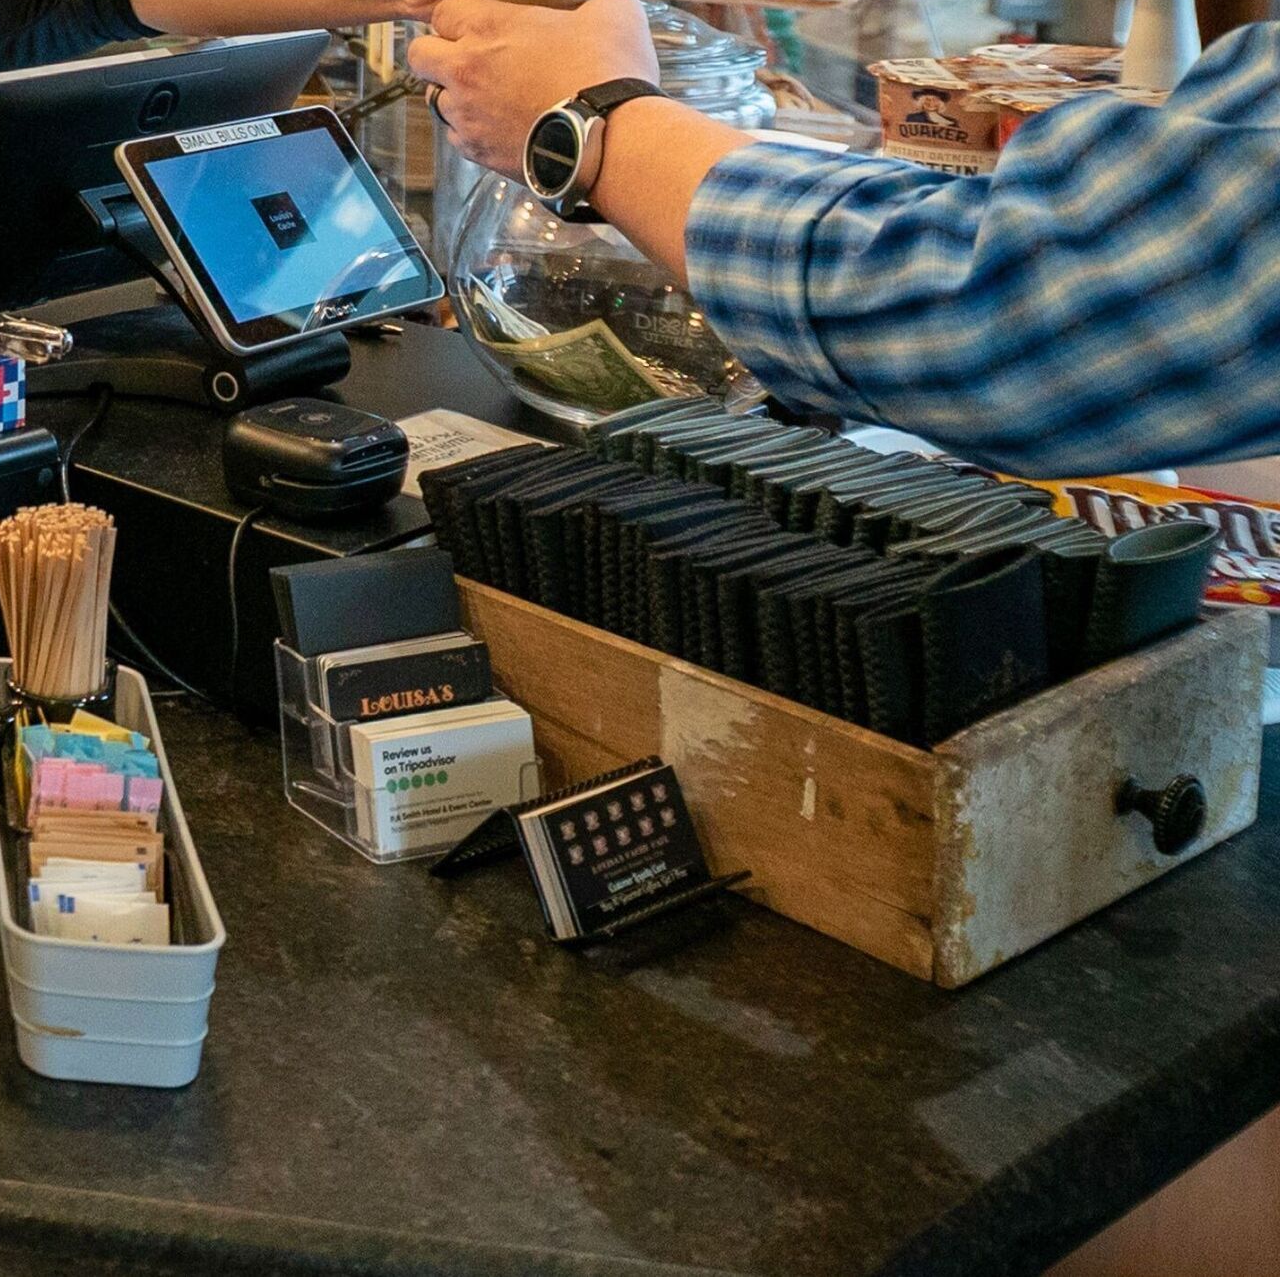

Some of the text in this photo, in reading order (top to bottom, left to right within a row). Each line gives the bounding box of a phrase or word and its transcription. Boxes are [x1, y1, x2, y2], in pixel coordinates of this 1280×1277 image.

[179, 121, 278, 150] SMALL BILLS ONLY
[899, 123, 969, 143] QUAKER
[361, 684, 454, 715] LOUISA'S
[382, 744, 433, 762] Review us
[384, 755, 457, 776] on Tripadvisor
